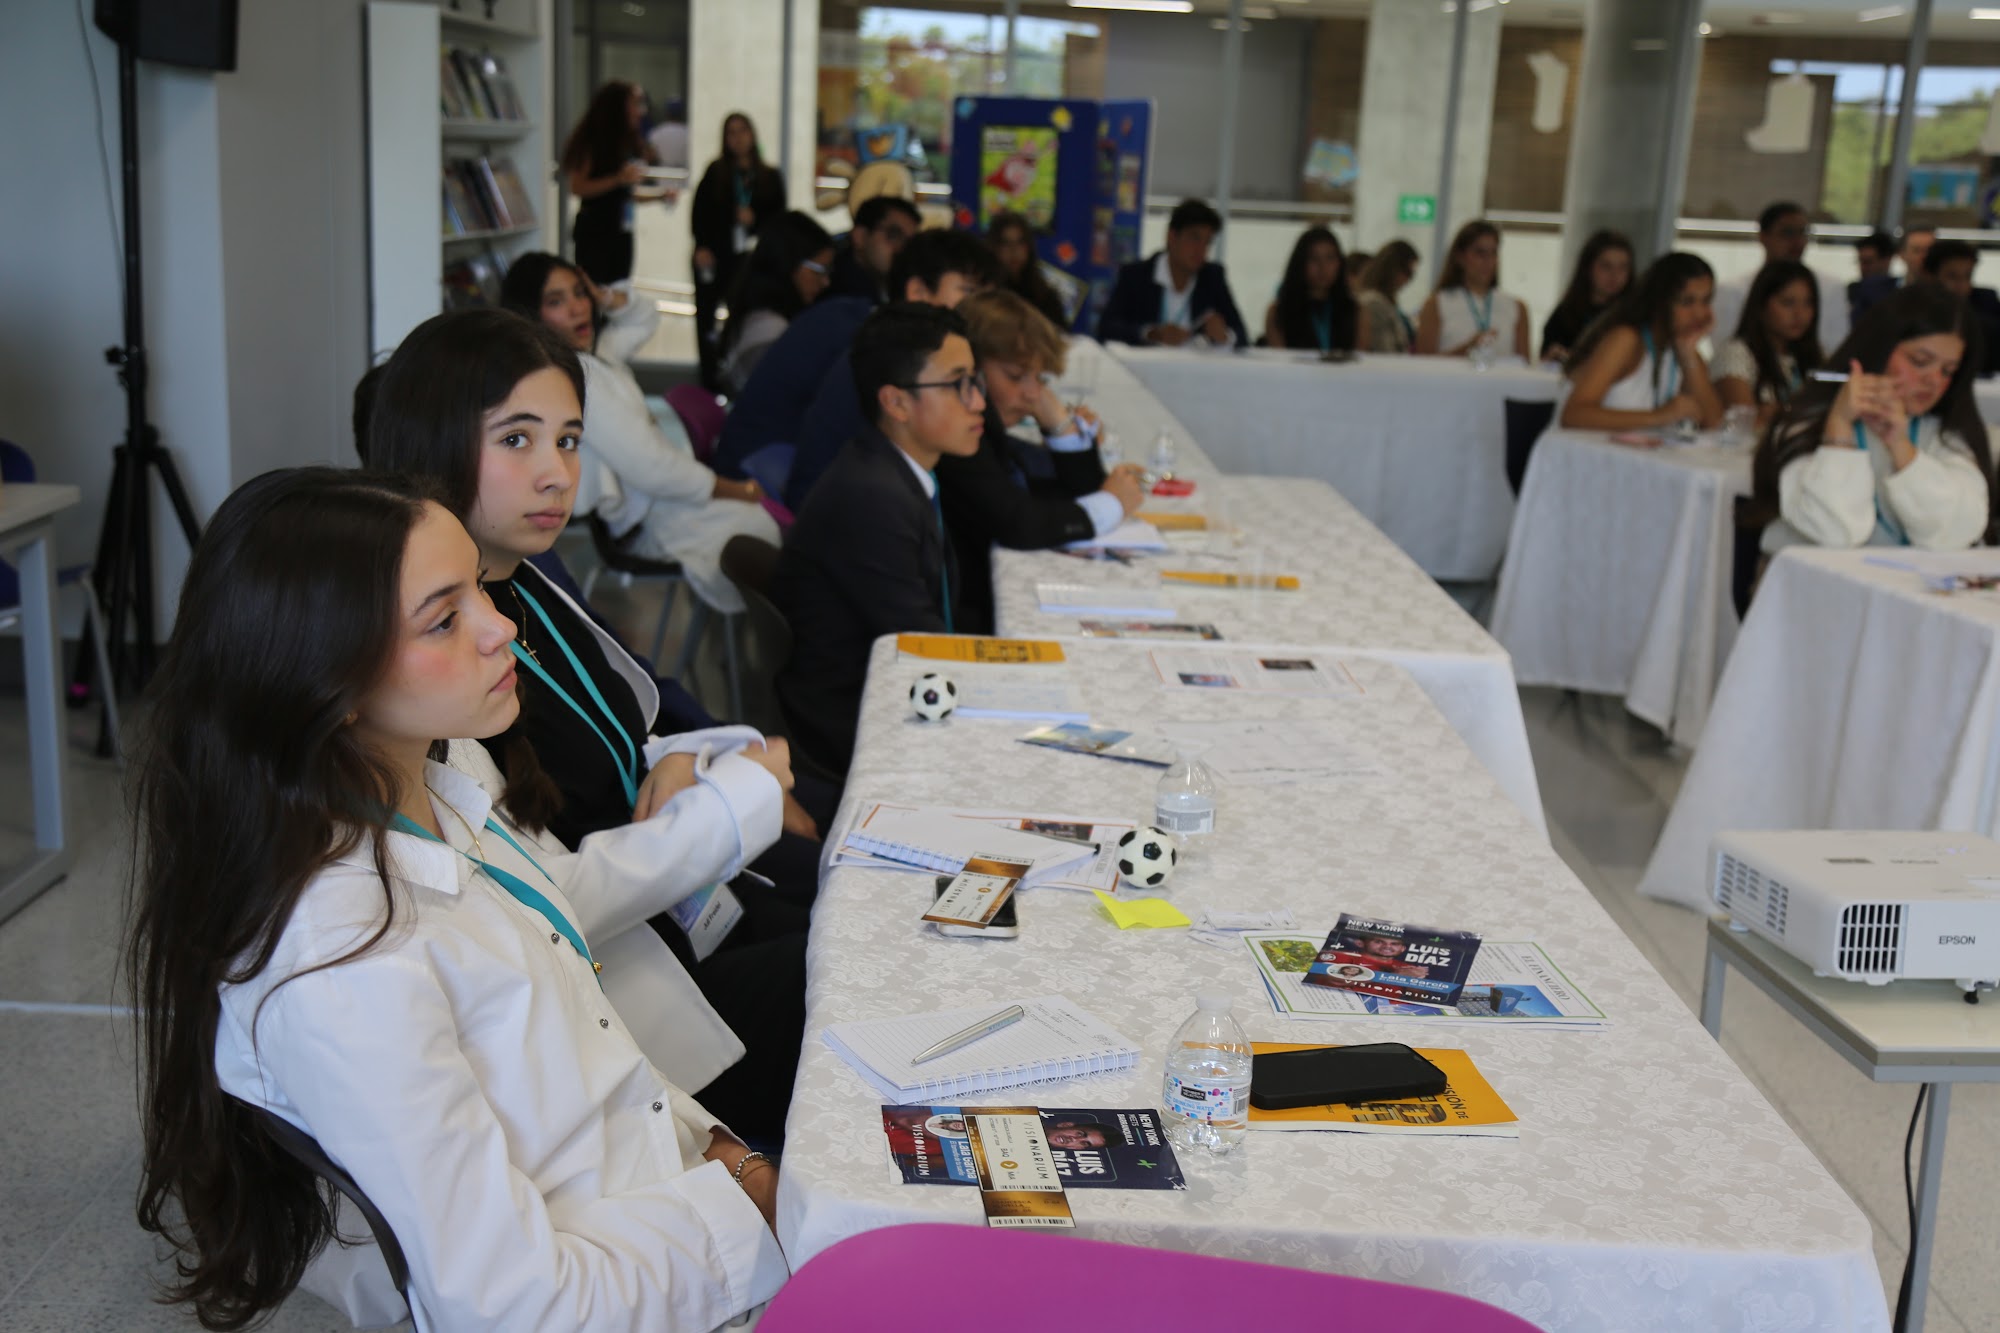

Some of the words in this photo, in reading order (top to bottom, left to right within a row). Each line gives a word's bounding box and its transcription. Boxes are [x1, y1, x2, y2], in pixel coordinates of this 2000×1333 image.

[1347, 919, 1374, 929] NEW
[1376, 922, 1406, 934] YORK
[1938, 935, 1976, 945] EPSON
[1408, 943, 1452, 957] LUIS
[1404, 952, 1452, 967] DÍAZ
[1380, 973, 1407, 982] Lala
[1409, 977, 1450, 989] García
[1344, 978, 1441, 1001] VISIONARIUM
[1138, 1113, 1154, 1128] NEW
[1116, 1113, 1136, 1146] BARRANQUILLA
[1143, 1129, 1161, 1146] YORK
[911, 1123, 930, 1176] VISIONARIUM
[1023, 1121, 1049, 1179] VISIONARIUM
[1074, 1150, 1105, 1175] LUIS
